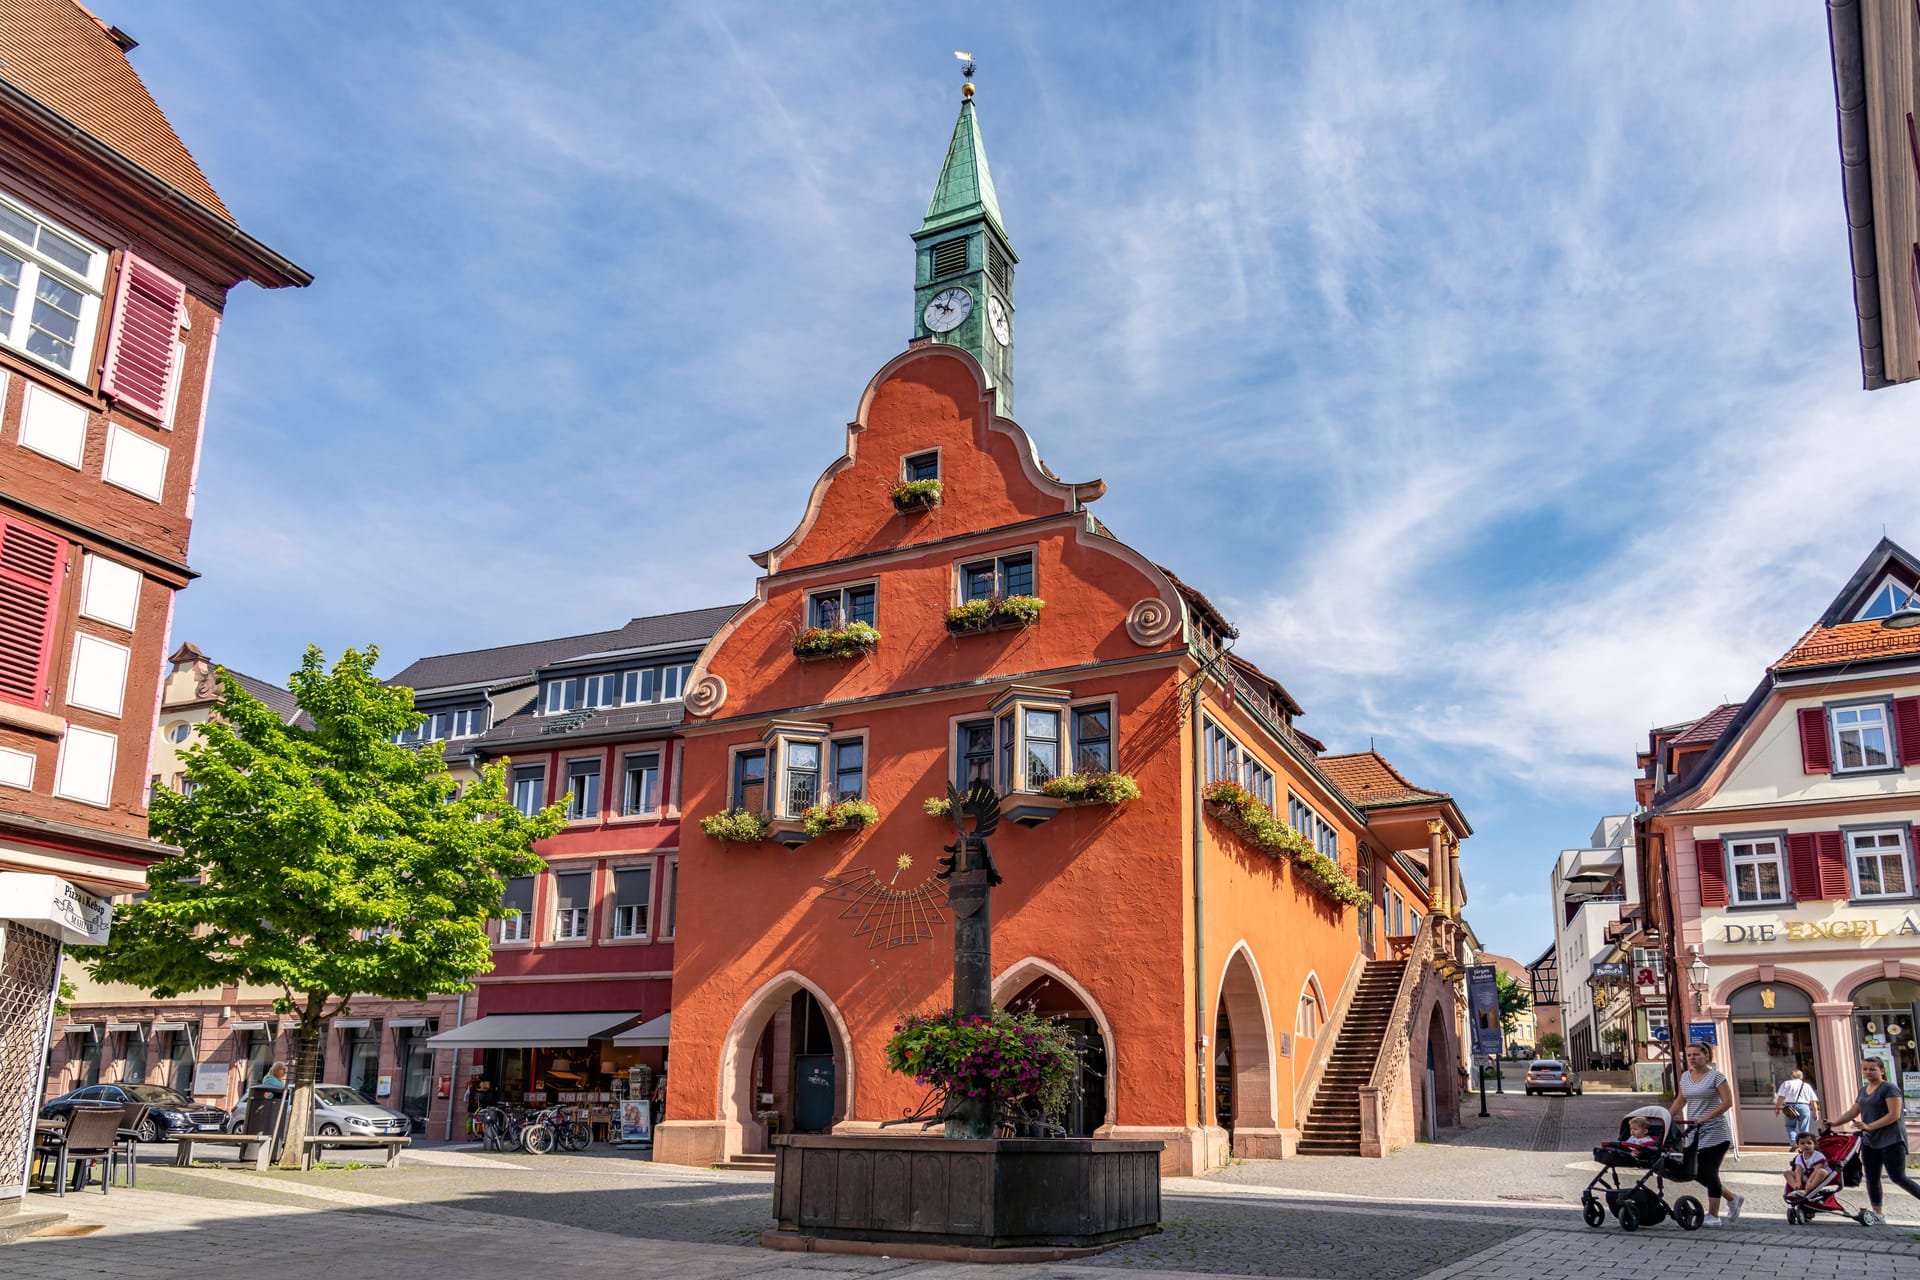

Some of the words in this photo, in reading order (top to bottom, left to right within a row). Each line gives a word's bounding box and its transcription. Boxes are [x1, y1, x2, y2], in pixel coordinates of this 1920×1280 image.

[64, 884, 82, 903] Pizza
[86, 895, 105, 916] Kebap
[1723, 924, 1776, 943] DIE
[1786, 919, 1888, 940] ENGEL
